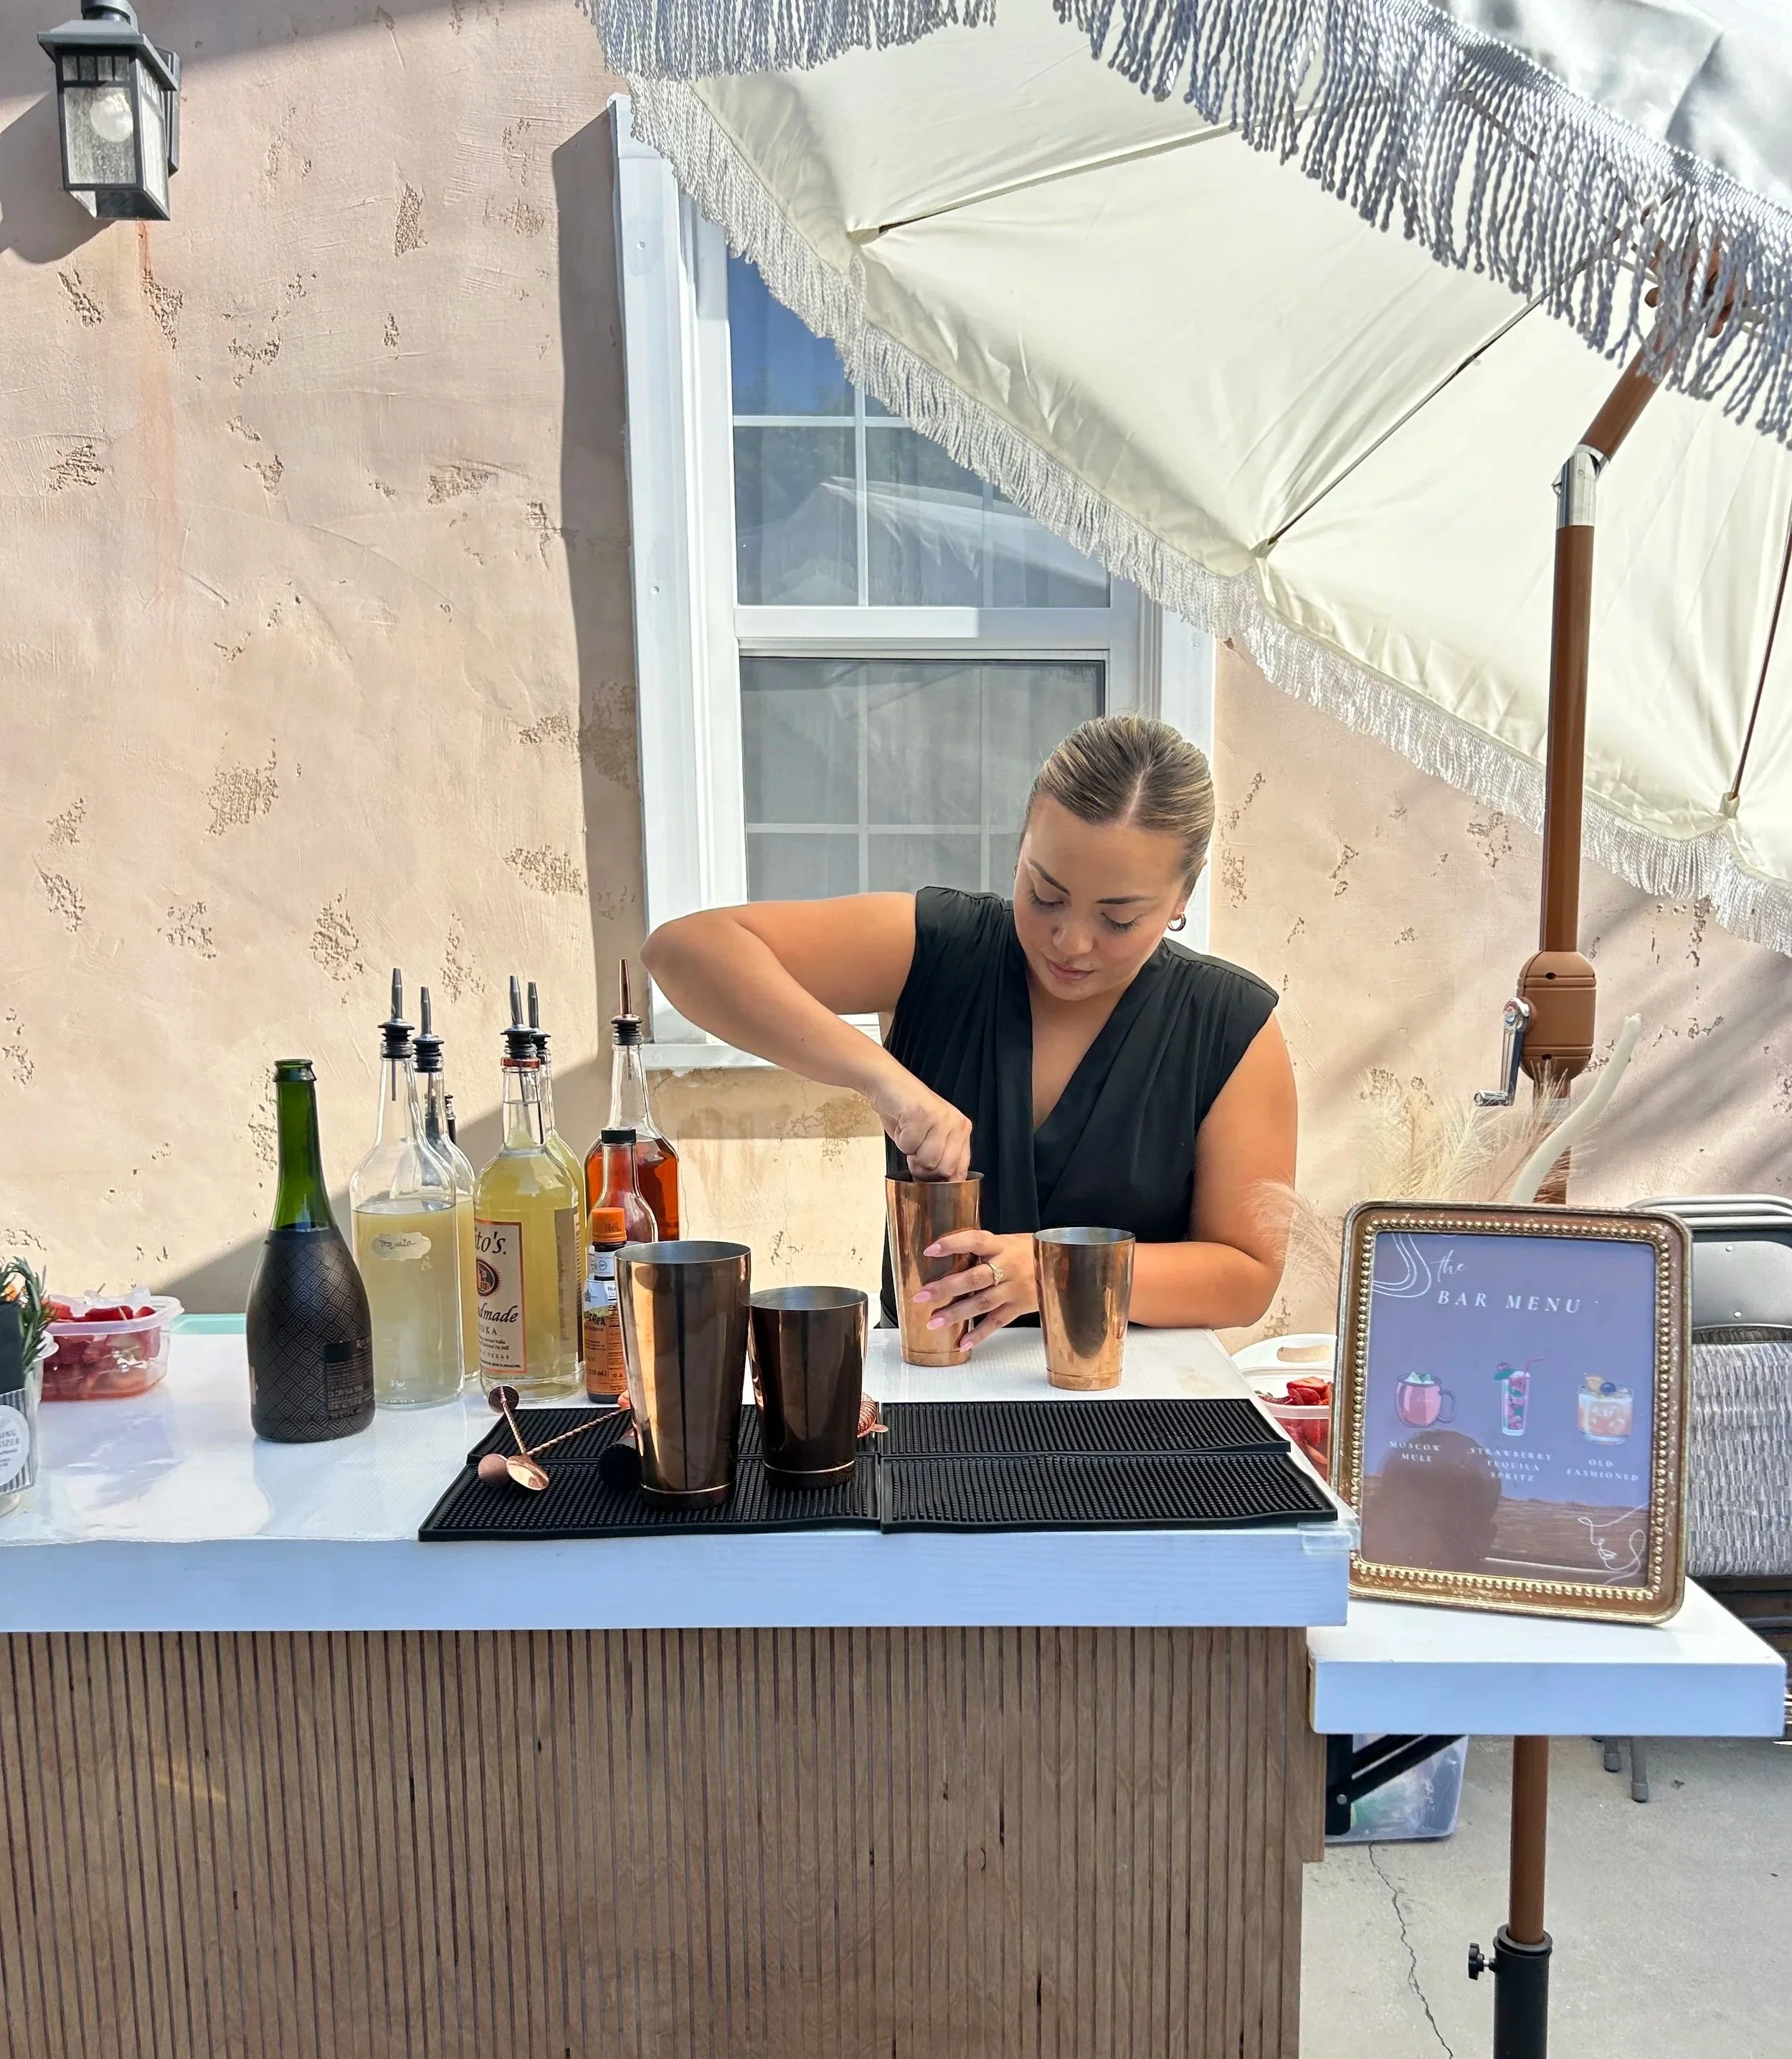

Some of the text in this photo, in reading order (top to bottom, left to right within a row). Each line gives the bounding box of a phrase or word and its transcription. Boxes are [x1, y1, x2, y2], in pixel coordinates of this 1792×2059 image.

[1430, 1249, 1467, 1283] the
[1438, 1290, 1581, 1314] BAR MENU
[1390, 1440, 1441, 1452] MOSCOW
[1401, 1452, 1433, 1463] MULE
[1469, 1447, 1552, 1462] STRAWBERRY
[1487, 1459, 1540, 1472] TEQUILA
[1588, 1459, 1613, 1468] OLD
[1490, 1471, 1535, 1482] SPRITZ
[1566, 1468, 1639, 1481] FASHIONED
